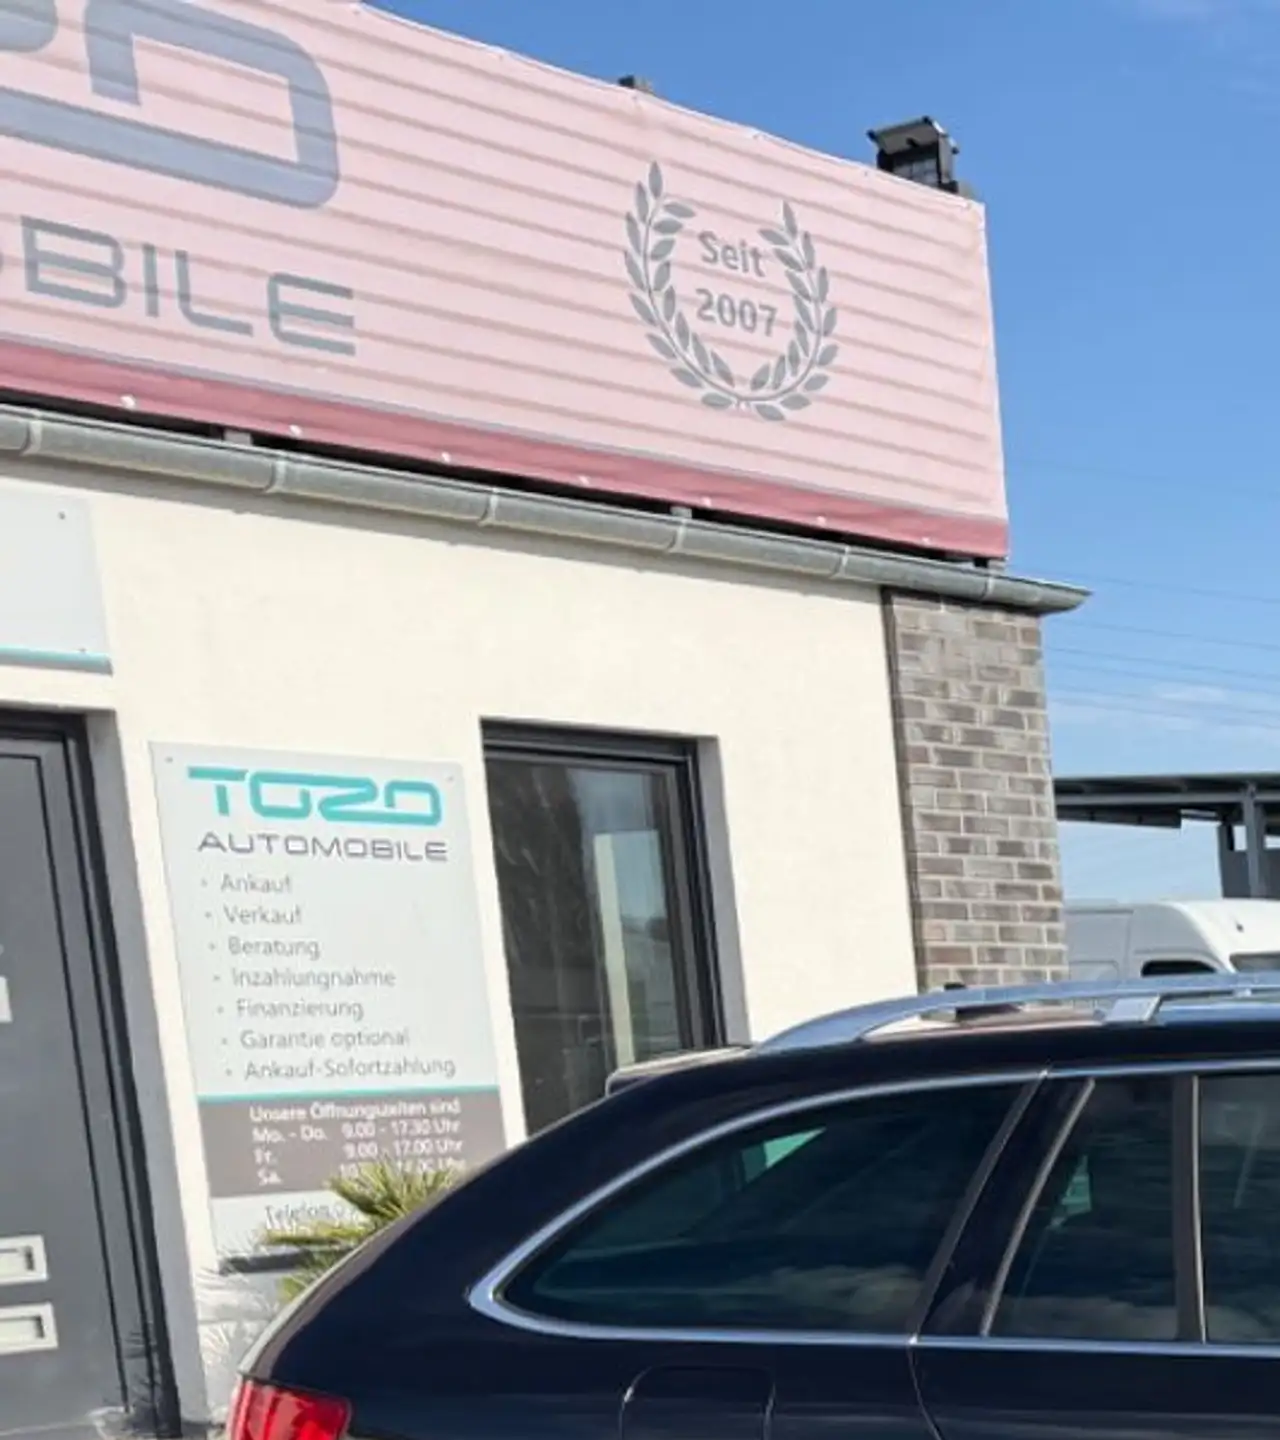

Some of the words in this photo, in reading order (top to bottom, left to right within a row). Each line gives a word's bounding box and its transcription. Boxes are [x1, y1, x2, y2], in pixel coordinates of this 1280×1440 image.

[697, 231, 765, 277] Seit
[0, 215, 356, 357] BILE
[695, 288, 777, 337] 2007
[197, 832, 448, 862] AUTOMOBILE
[220, 874, 293, 894] Ankauf
[223, 905, 302, 925] Verkauf
[228, 935, 320, 960] Beratung
[232, 967, 396, 990] Inzahlungnahme
[237, 998, 364, 1021] Finanzierung
[240, 1029, 325, 1049] Garantie
[330, 1027, 410, 1050] optional
[244, 1055, 456, 1080] Ankauf-Sofortzahlung
[249, 1105, 307, 1122] Unsere
[433, 1117, 460, 1133] Uhr
